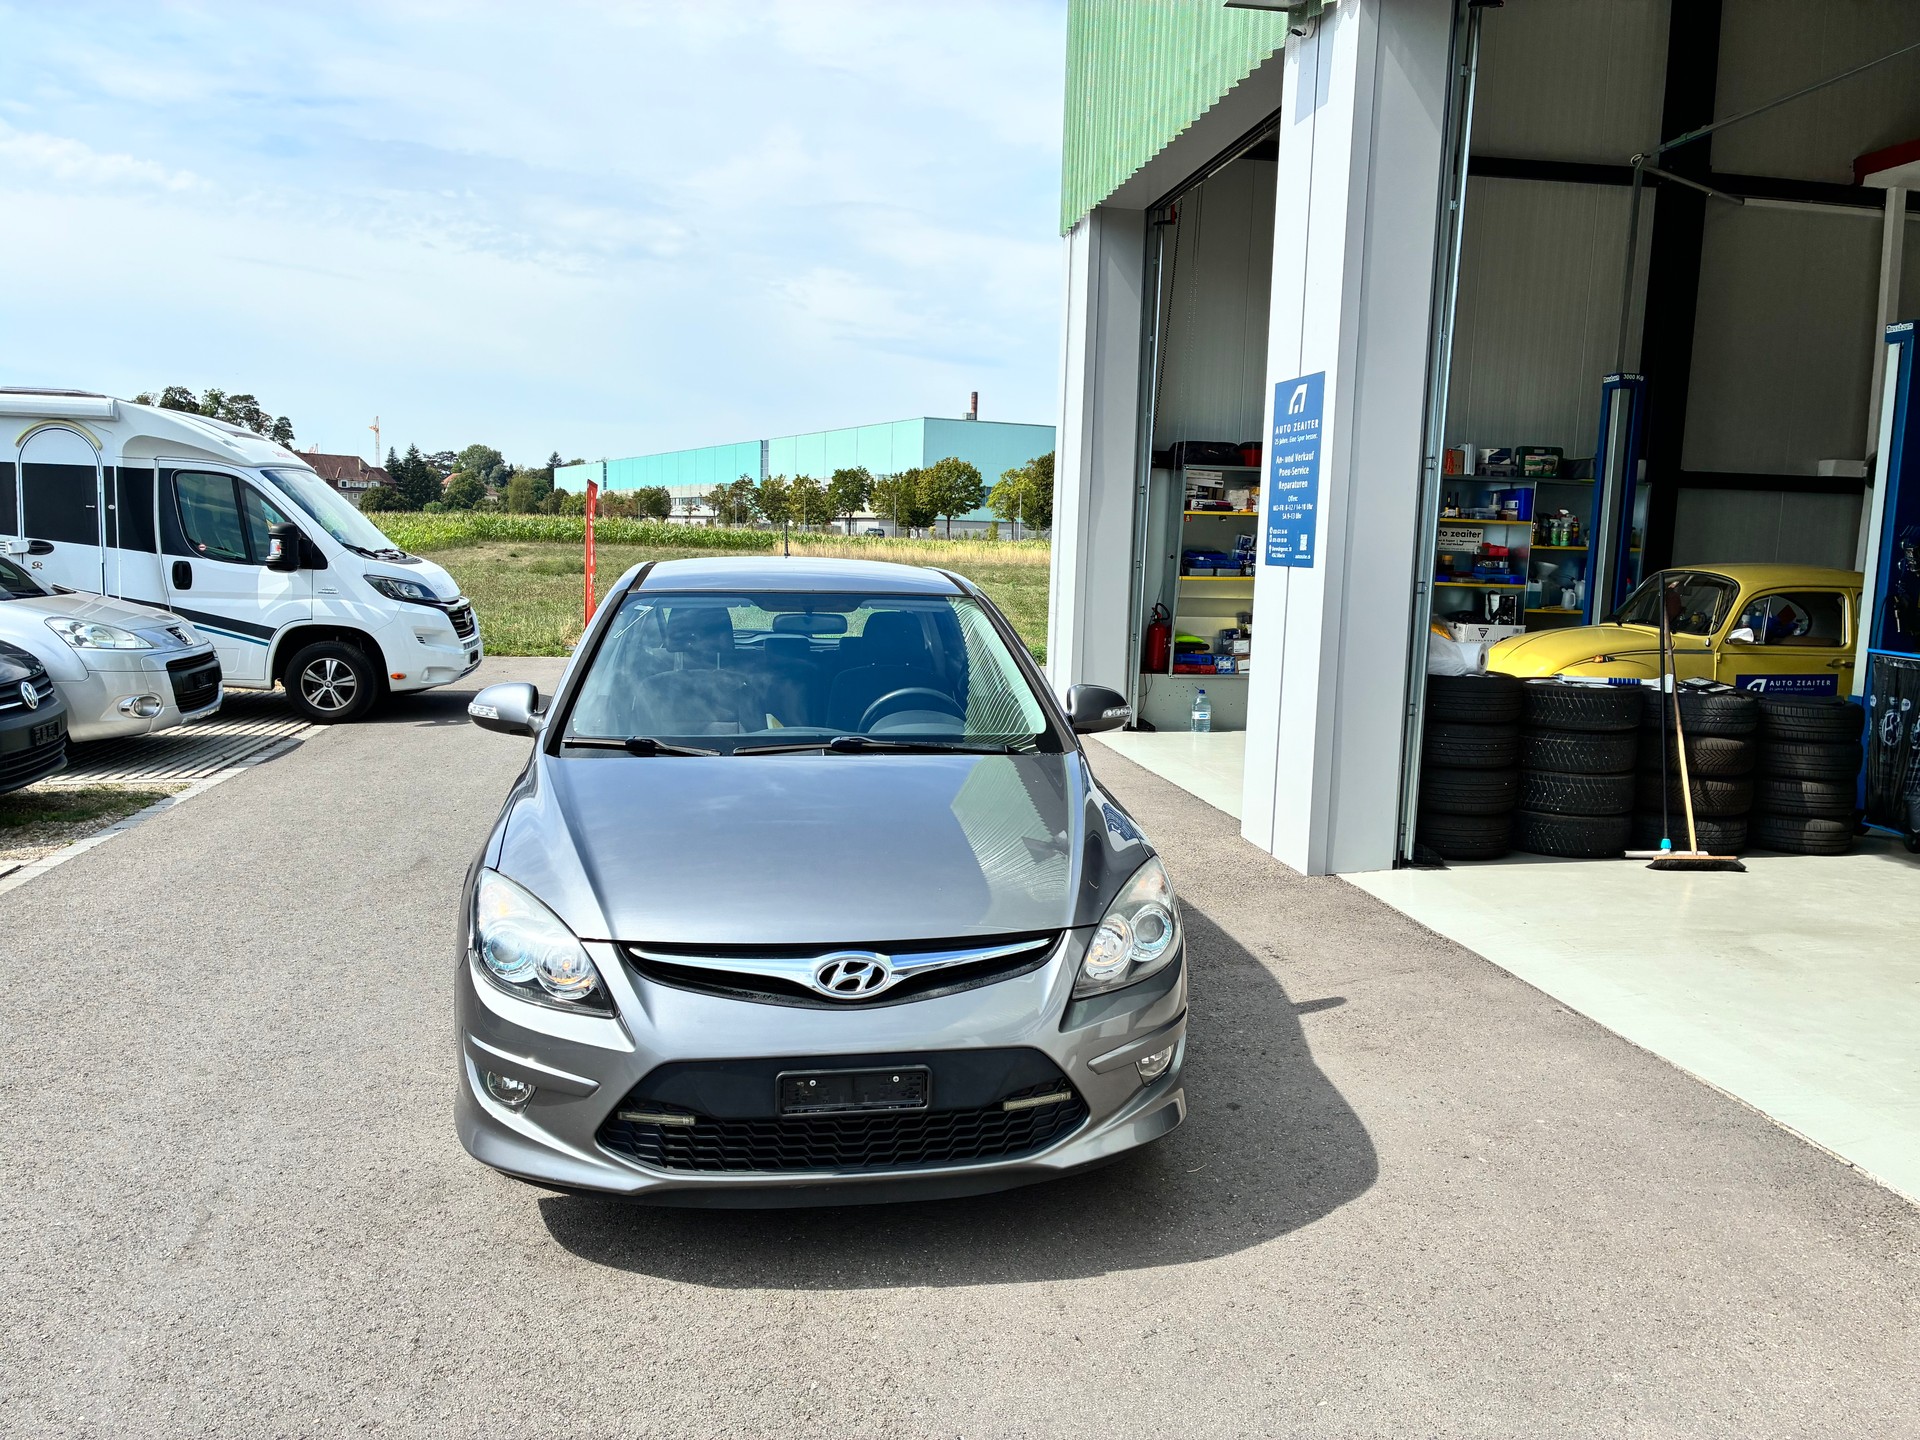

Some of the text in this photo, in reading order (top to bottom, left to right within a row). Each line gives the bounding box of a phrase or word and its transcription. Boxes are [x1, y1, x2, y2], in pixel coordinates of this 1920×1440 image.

[1275, 419, 1319, 435] AUTO ZEAITER
[1295, 450, 1315, 462] Verkauf
[1278, 480, 1308, 492] Reparaturen
[1450, 530, 1481, 538] zeaiter
